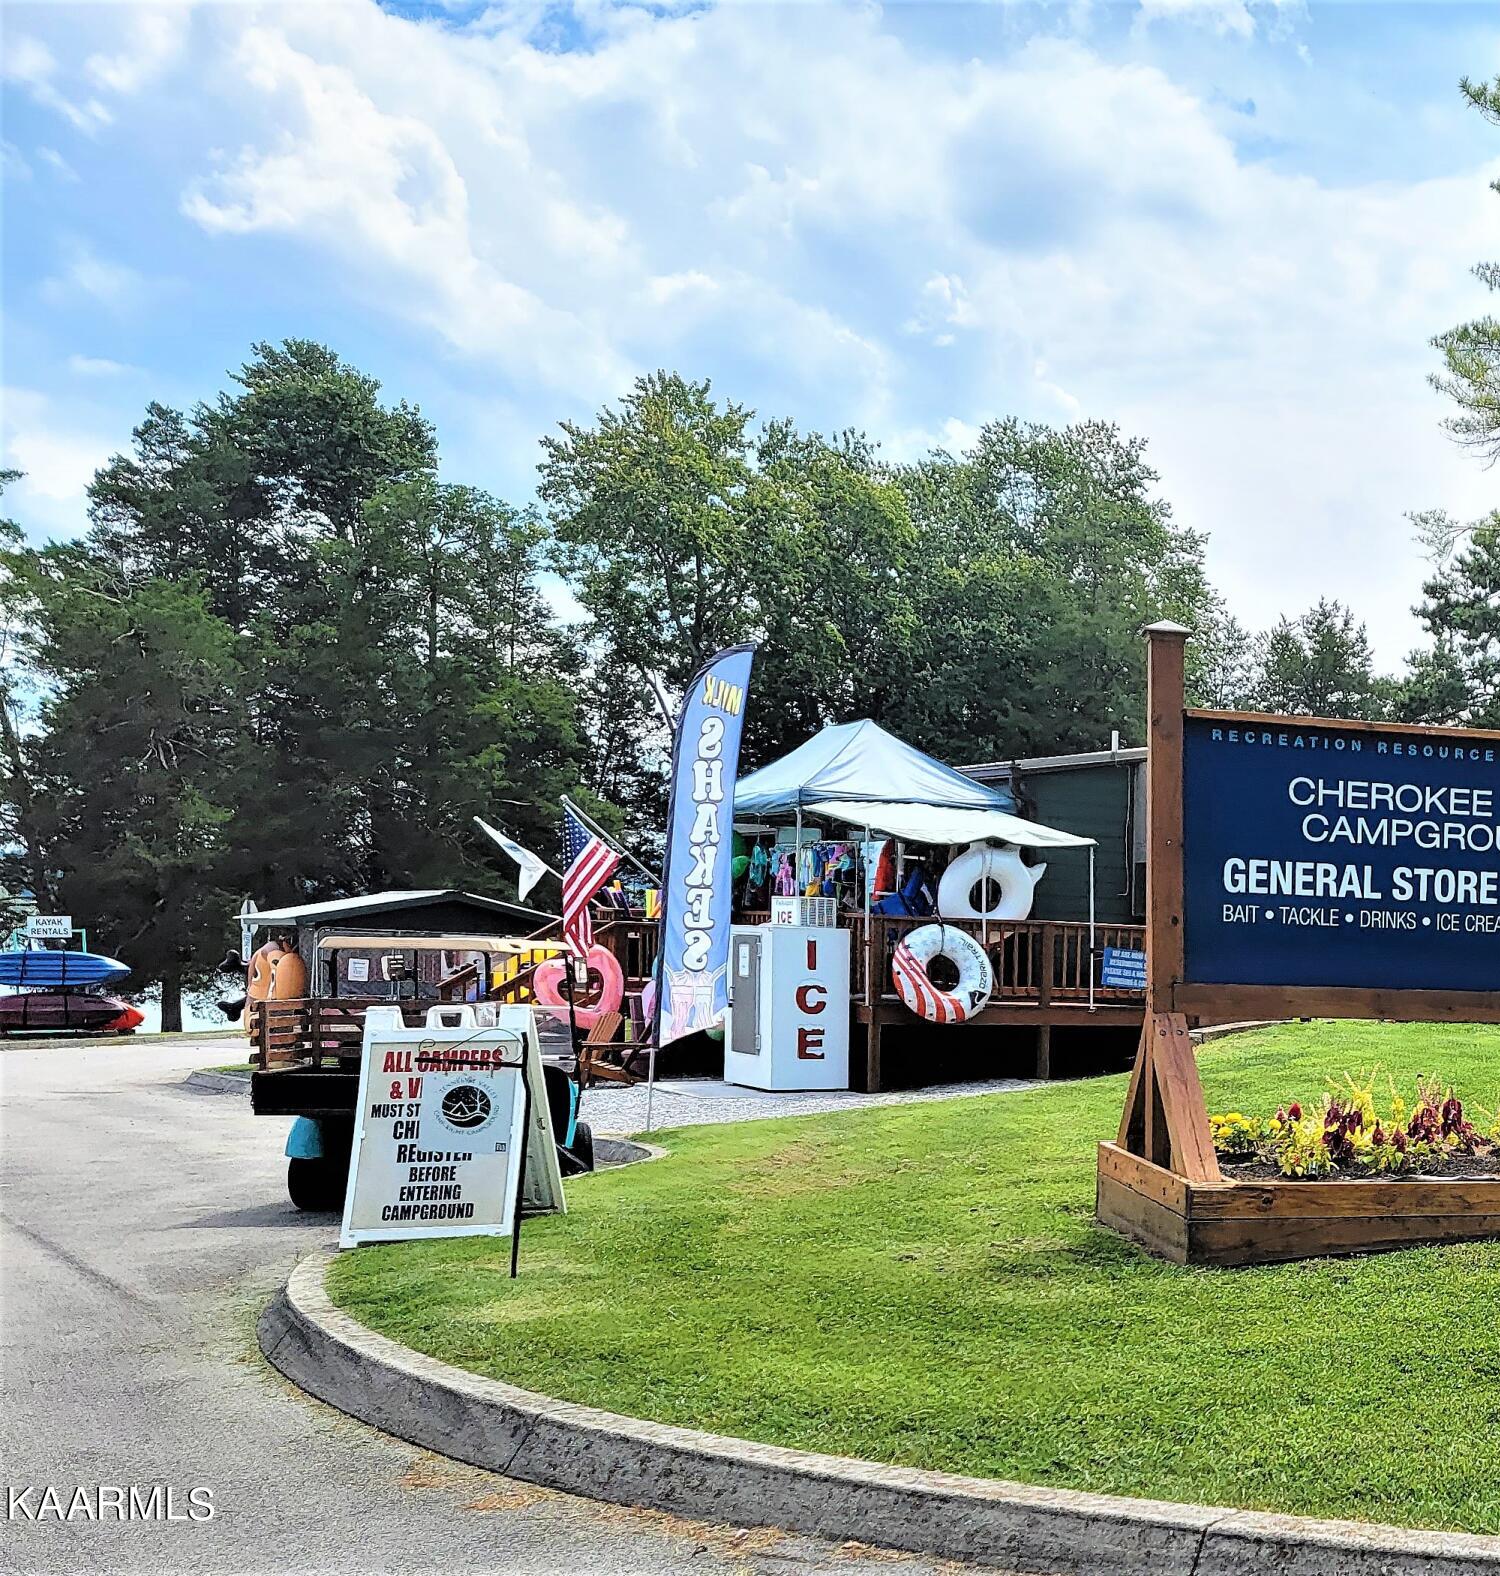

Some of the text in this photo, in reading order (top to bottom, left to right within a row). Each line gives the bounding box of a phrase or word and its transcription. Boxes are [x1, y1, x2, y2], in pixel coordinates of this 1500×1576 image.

[1211, 728, 1362, 752] RECREATION
[1377, 741, 1495, 762] RESOURCE
[1288, 776, 1493, 818] CHEROKEE
[1223, 857, 1382, 900] GENERAL
[1391, 866, 1498, 905] STORE
[35, 918, 63, 926] KAYAK
[777, 910, 792, 924] ICE
[1222, 904, 1260, 923] BAIT
[1279, 906, 1340, 927] TACKLE
[1360, 910, 1417, 930] DRINKS
[1436, 913, 1460, 932] ICE
[30, 927, 69, 936] RENTALS
[796, 936, 828, 1060] ICE
[383, 1049, 503, 1073] ALL CAMPERS
[389, 1080, 403, 1100] &
[371, 1103, 404, 1118] MUST
[408, 1166, 457, 1182] BEFORE
[399, 1184, 461, 1201] ENTERING
[381, 1203, 474, 1221] CAMPGROUND
